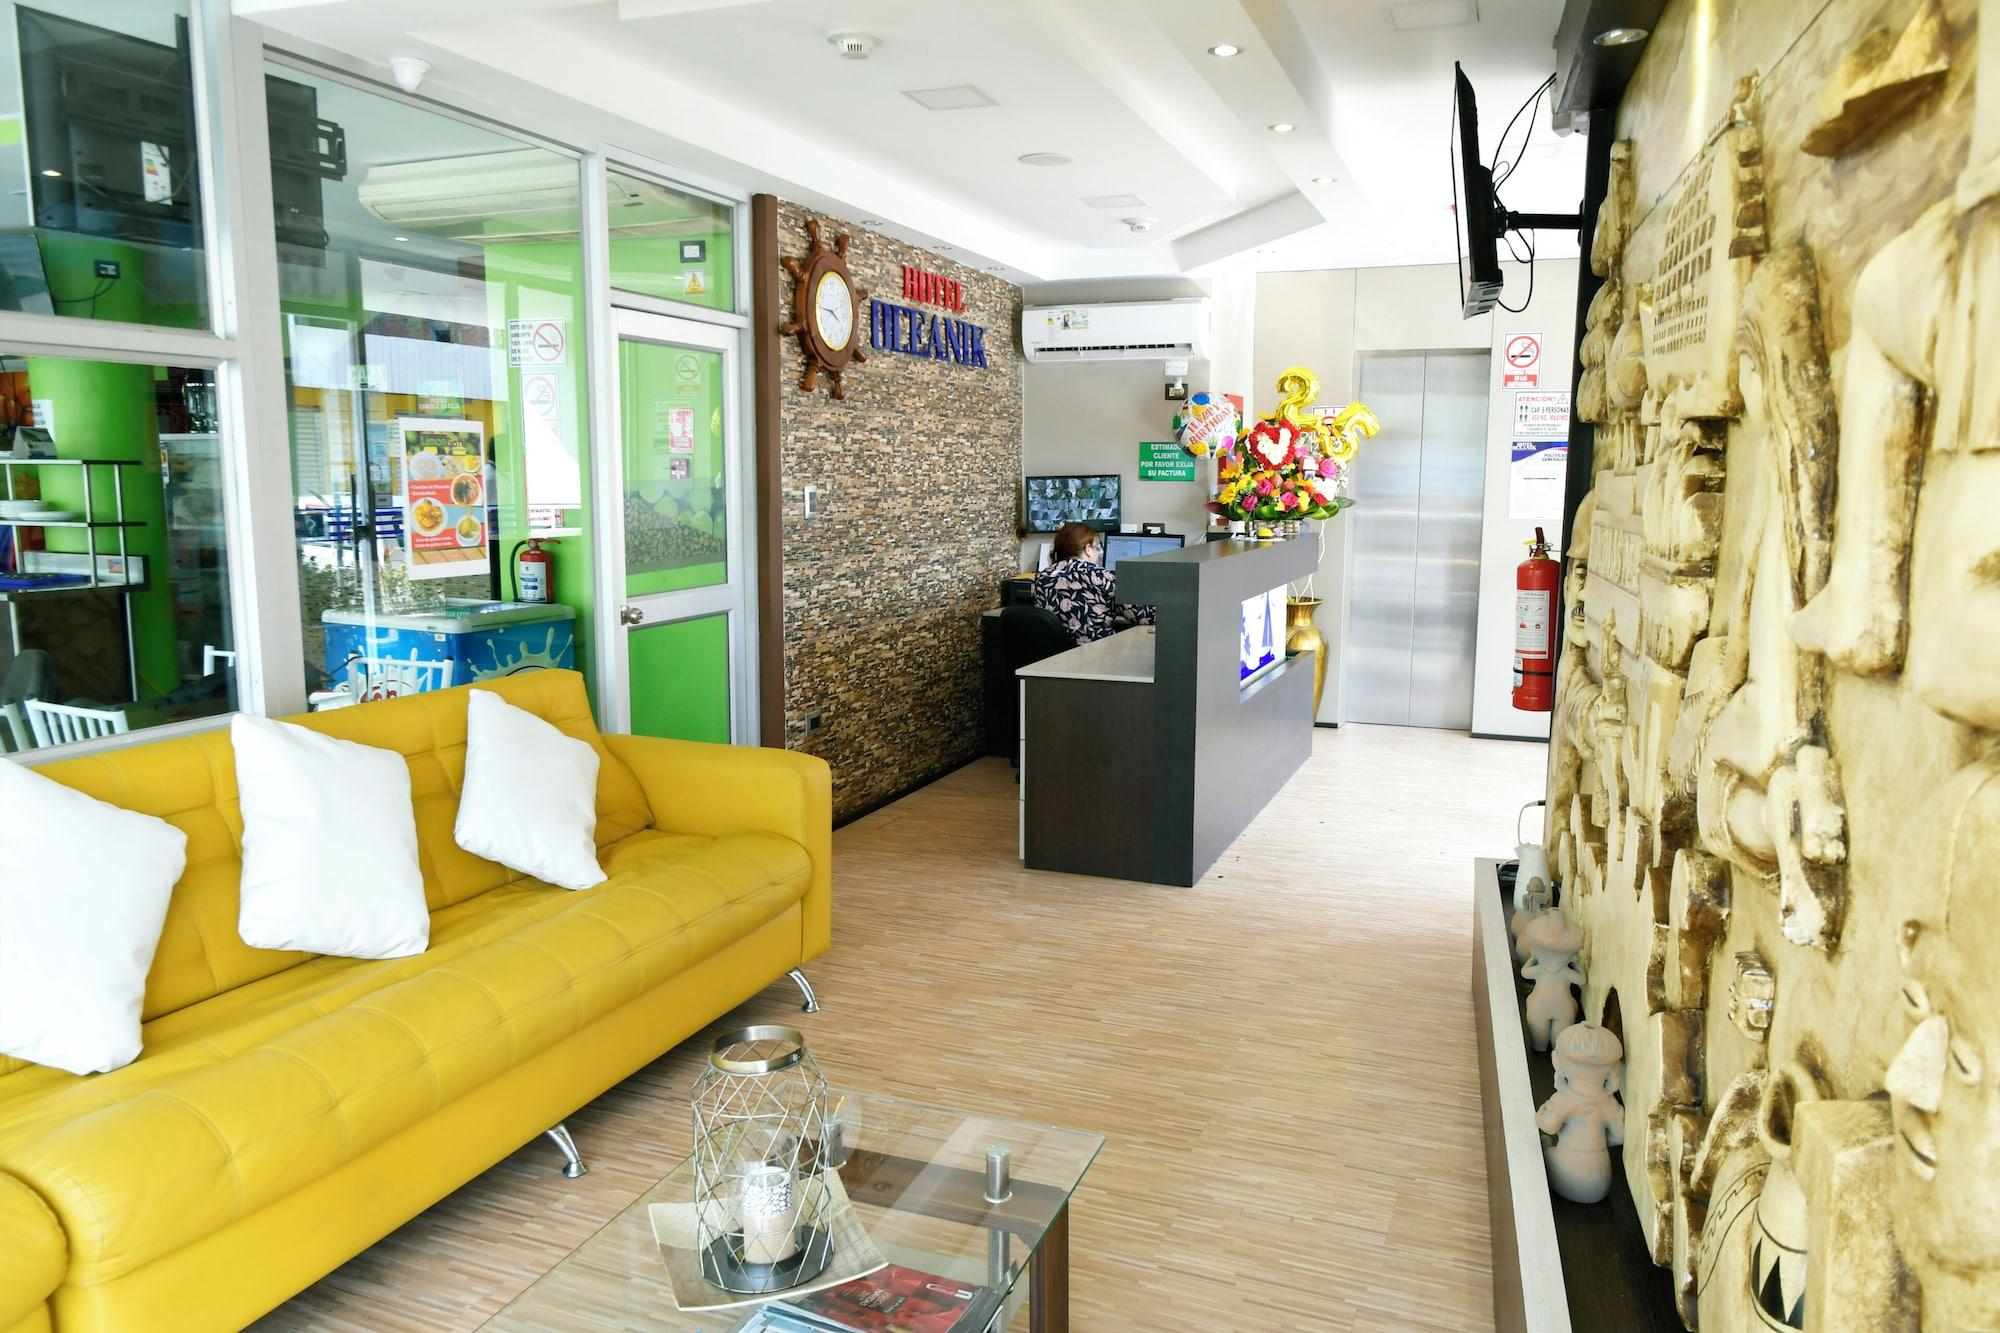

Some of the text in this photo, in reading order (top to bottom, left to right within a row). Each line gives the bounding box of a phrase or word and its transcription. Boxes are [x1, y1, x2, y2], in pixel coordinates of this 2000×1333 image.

[903, 264, 968, 313] HOTEL
[870, 298, 988, 369] OCEANIK
[1189, 406, 1231, 445] BIRTHDAY
